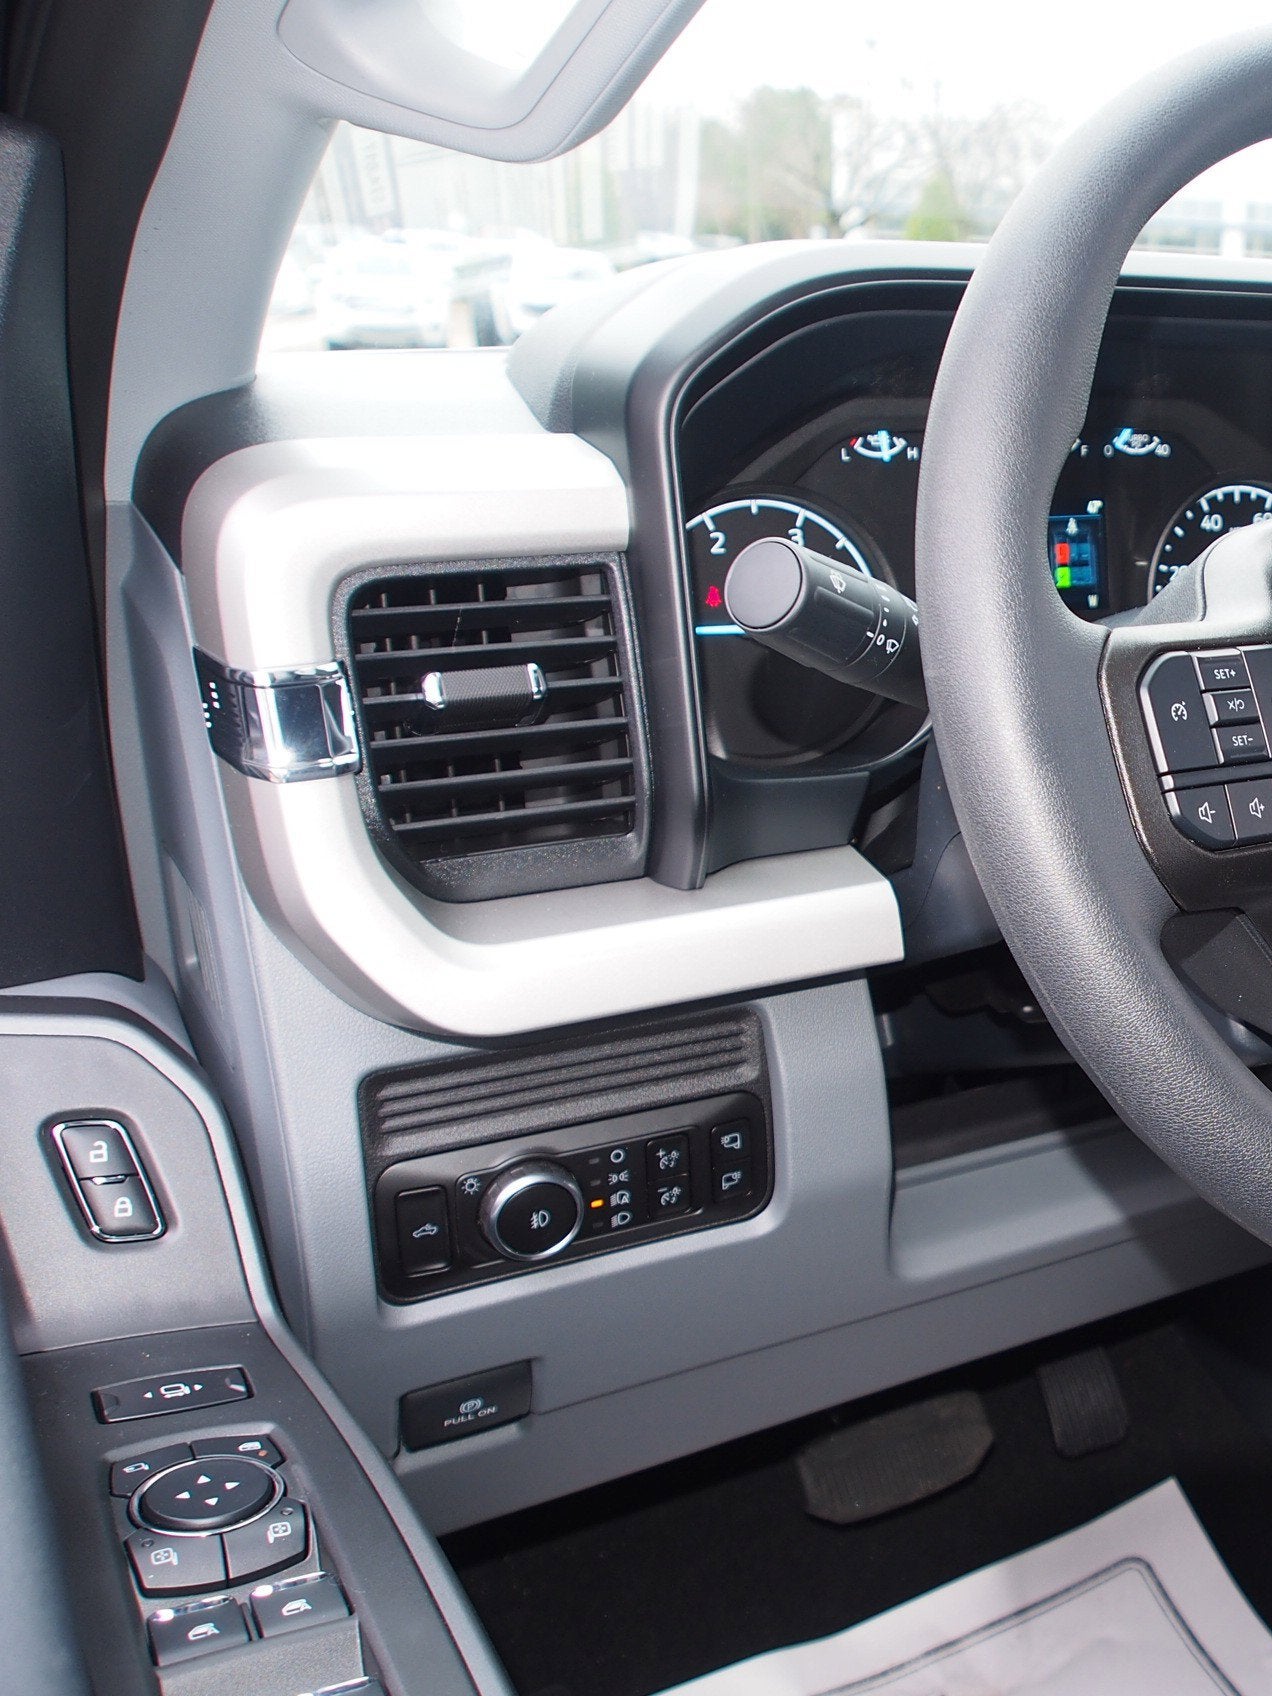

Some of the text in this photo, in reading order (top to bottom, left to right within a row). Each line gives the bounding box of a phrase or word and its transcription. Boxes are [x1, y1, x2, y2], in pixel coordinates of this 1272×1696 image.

[841, 448, 851, 461] L
[907, 447, 919, 460] H
[1154, 444, 1171, 458] 40
[1200, 514, 1223, 532] 40
[710, 532, 726, 555] 2
[788, 528, 804, 547] 3
[444, 1406, 496, 1427] PULL ON
